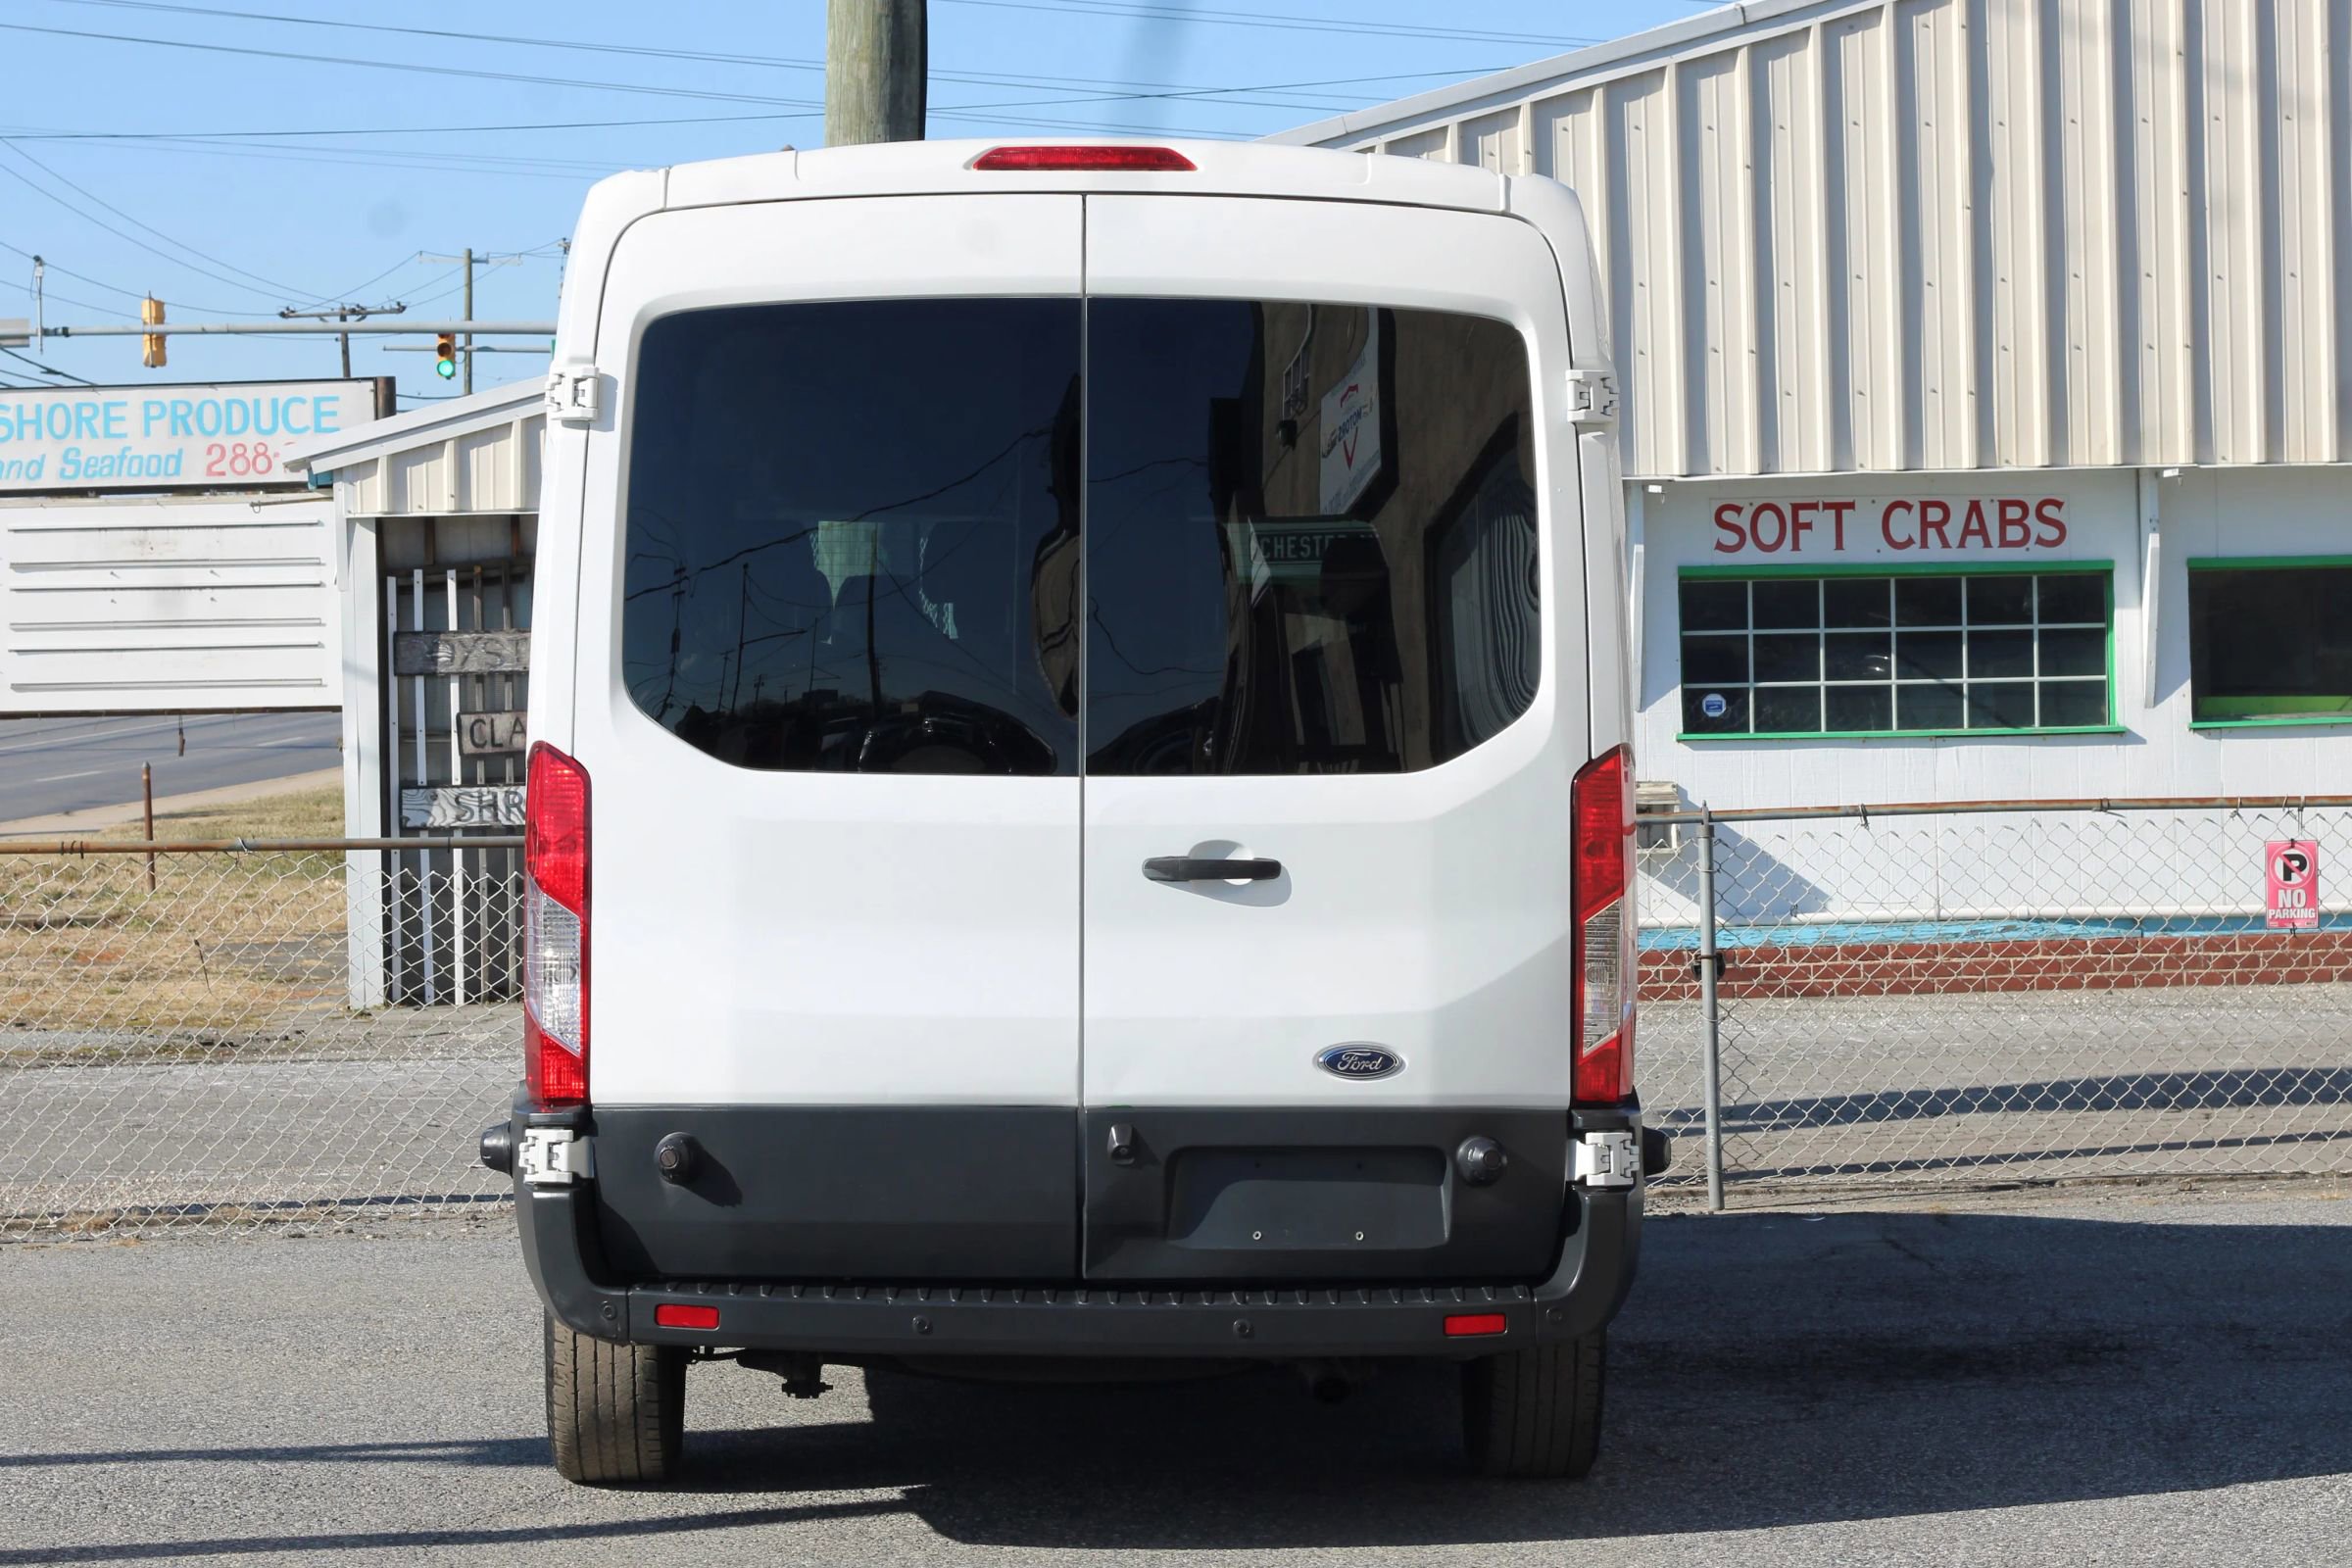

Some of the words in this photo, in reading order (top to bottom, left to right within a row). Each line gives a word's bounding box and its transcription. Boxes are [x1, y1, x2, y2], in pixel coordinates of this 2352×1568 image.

[0, 401, 127, 443] SHORE
[143, 396, 341, 438] PRODUCE
[59, 446, 183, 480] Seafood
[1713, 500, 1856, 554] SOFT
[1881, 498, 2068, 551] CRABS
[469, 716, 527, 749] CLA
[2268, 907, 2316, 919] PARKING
[2278, 889, 2307, 908] NO
[1337, 1052, 1383, 1071] Ford
